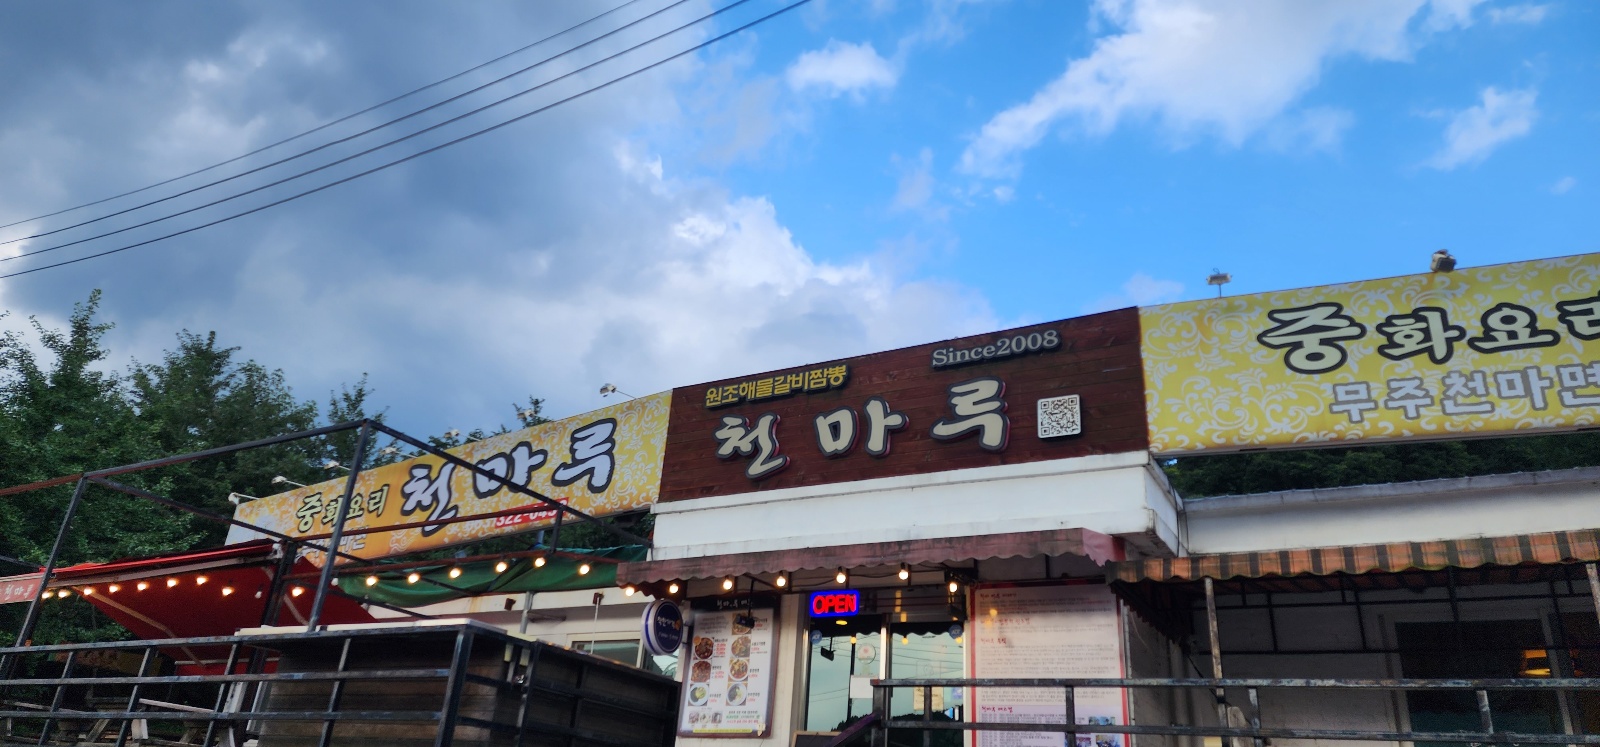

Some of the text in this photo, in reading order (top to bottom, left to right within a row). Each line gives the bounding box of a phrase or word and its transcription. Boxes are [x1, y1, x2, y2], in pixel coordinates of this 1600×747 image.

[932, 330, 1060, 368] Since2008
[705, 365, 848, 407] 원조해물갈비짬뽕
[713, 376, 1012, 481] 천마루
[400, 417, 617, 536] 천마루
[295, 483, 390, 533] 중화요리
[813, 595, 856, 614] OPEN
